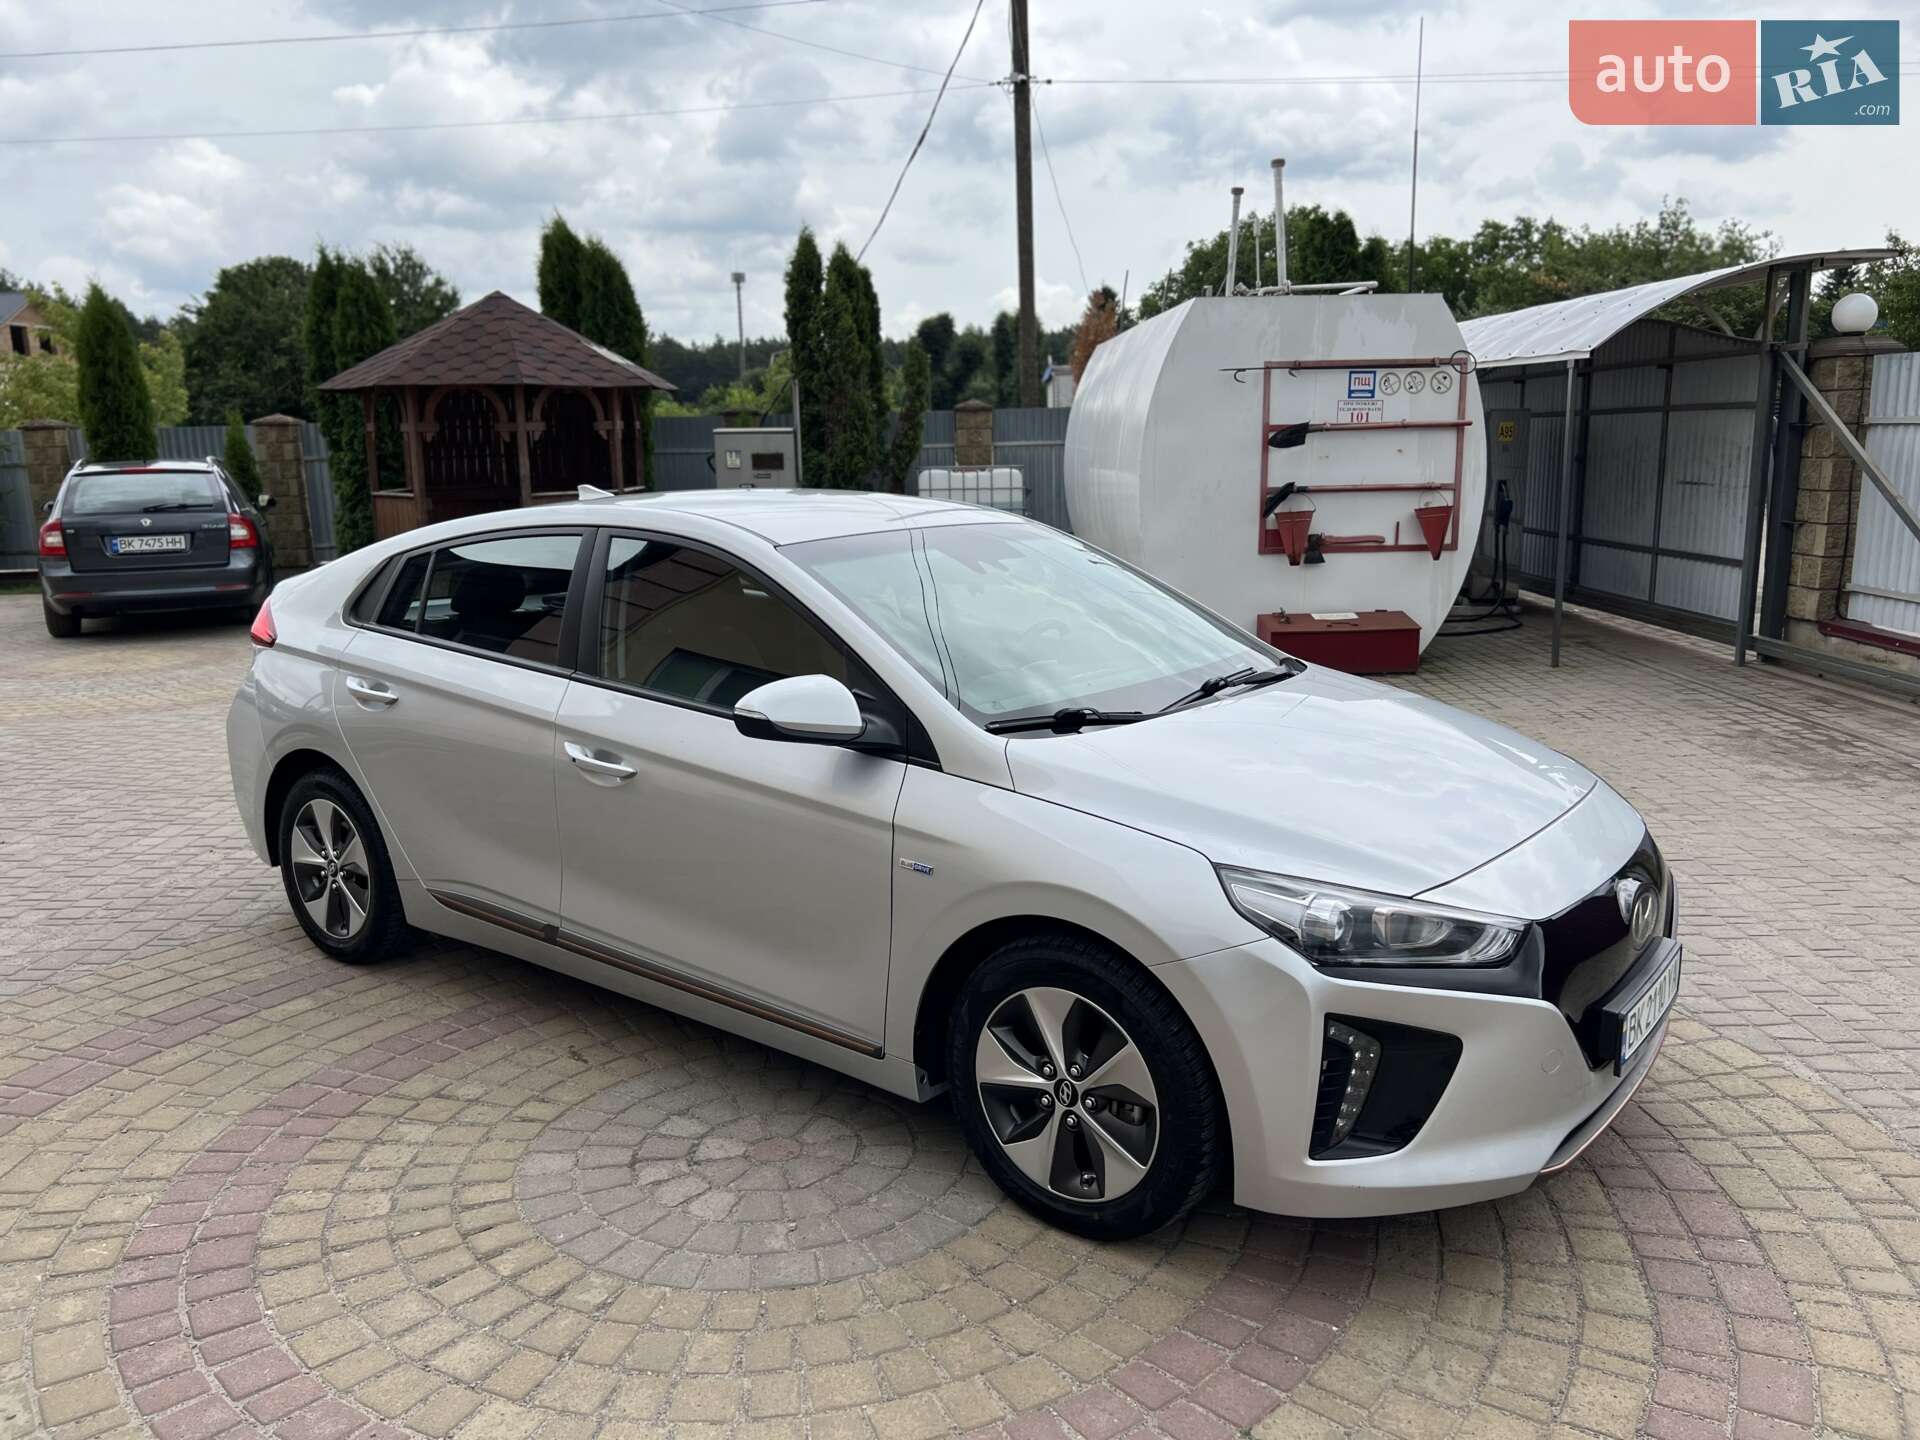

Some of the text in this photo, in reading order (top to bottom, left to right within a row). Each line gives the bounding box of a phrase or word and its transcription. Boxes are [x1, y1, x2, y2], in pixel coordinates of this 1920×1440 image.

[1350, 411, 1369, 423] 101
[119, 536, 182, 550] BK 7475 HH
[1628, 1002, 1645, 1049] BK
